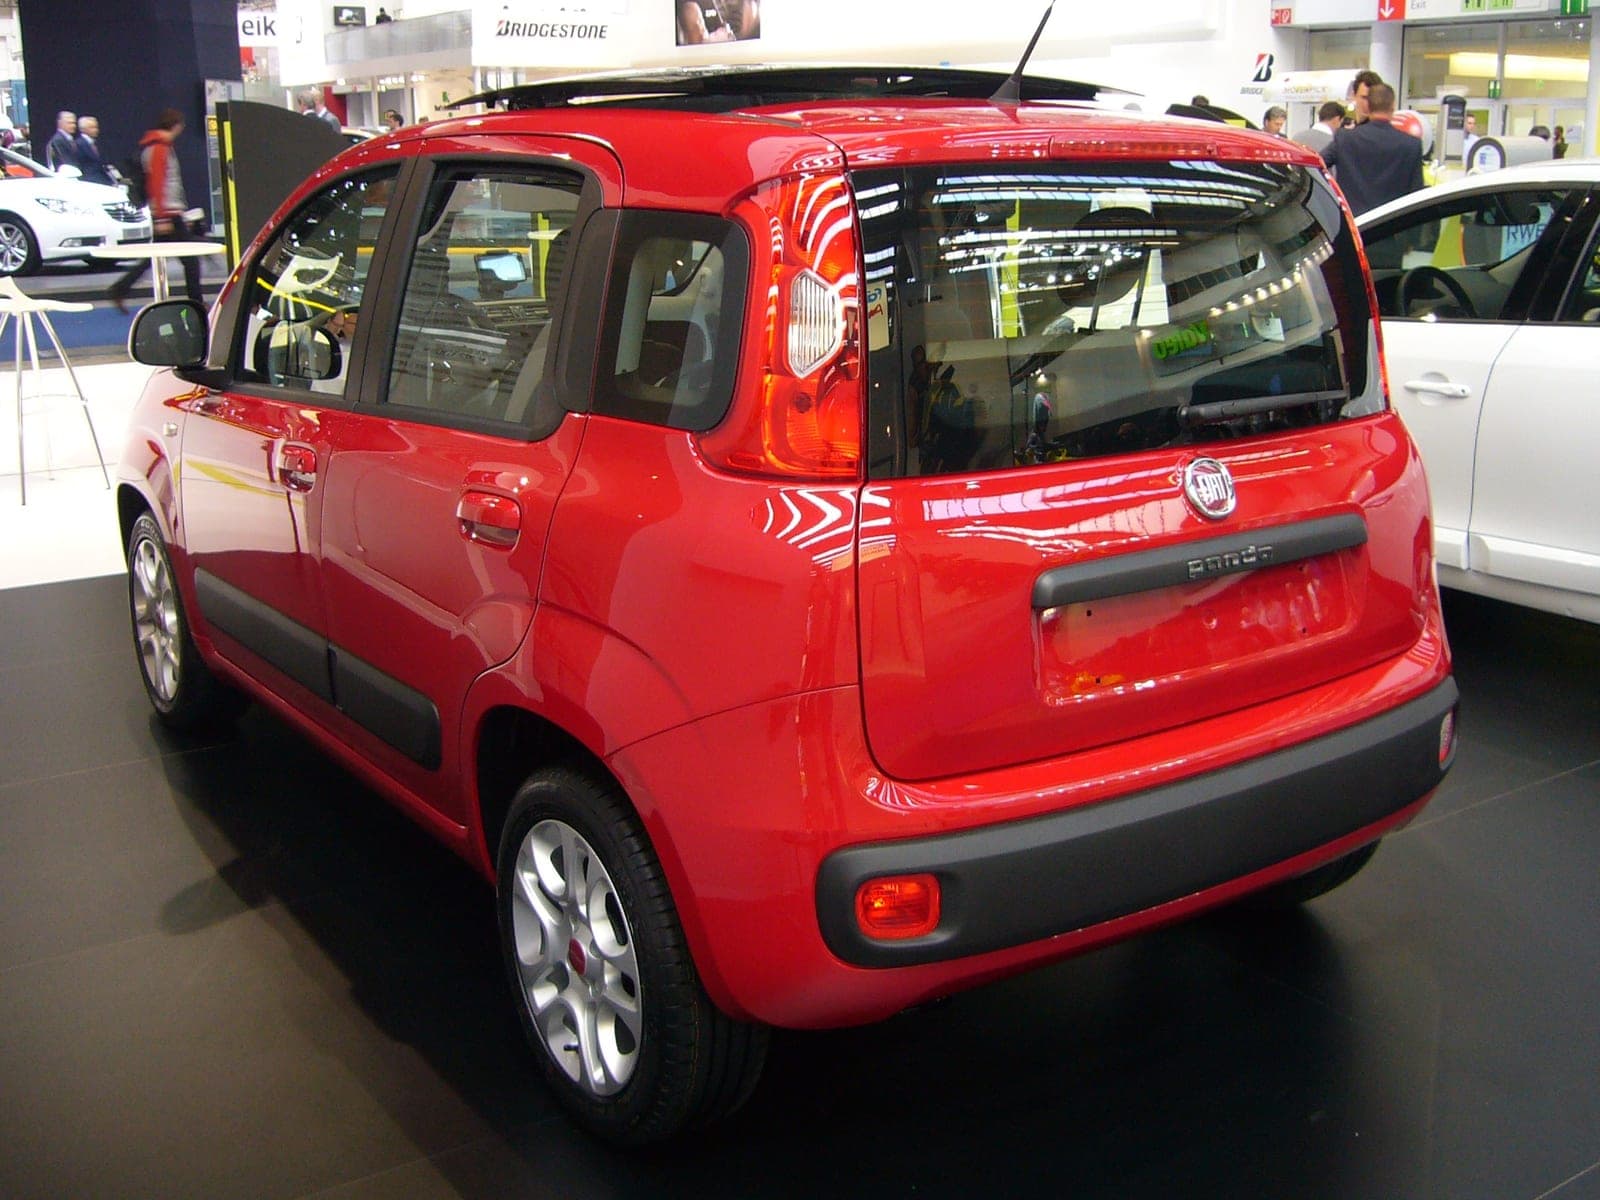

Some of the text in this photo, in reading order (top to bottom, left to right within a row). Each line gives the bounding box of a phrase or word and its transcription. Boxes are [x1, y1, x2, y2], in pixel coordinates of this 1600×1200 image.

[242, 15, 276, 36] eik
[497, 19, 608, 39] BRIDGESTONE
[1196, 472, 1229, 506] FIAT
